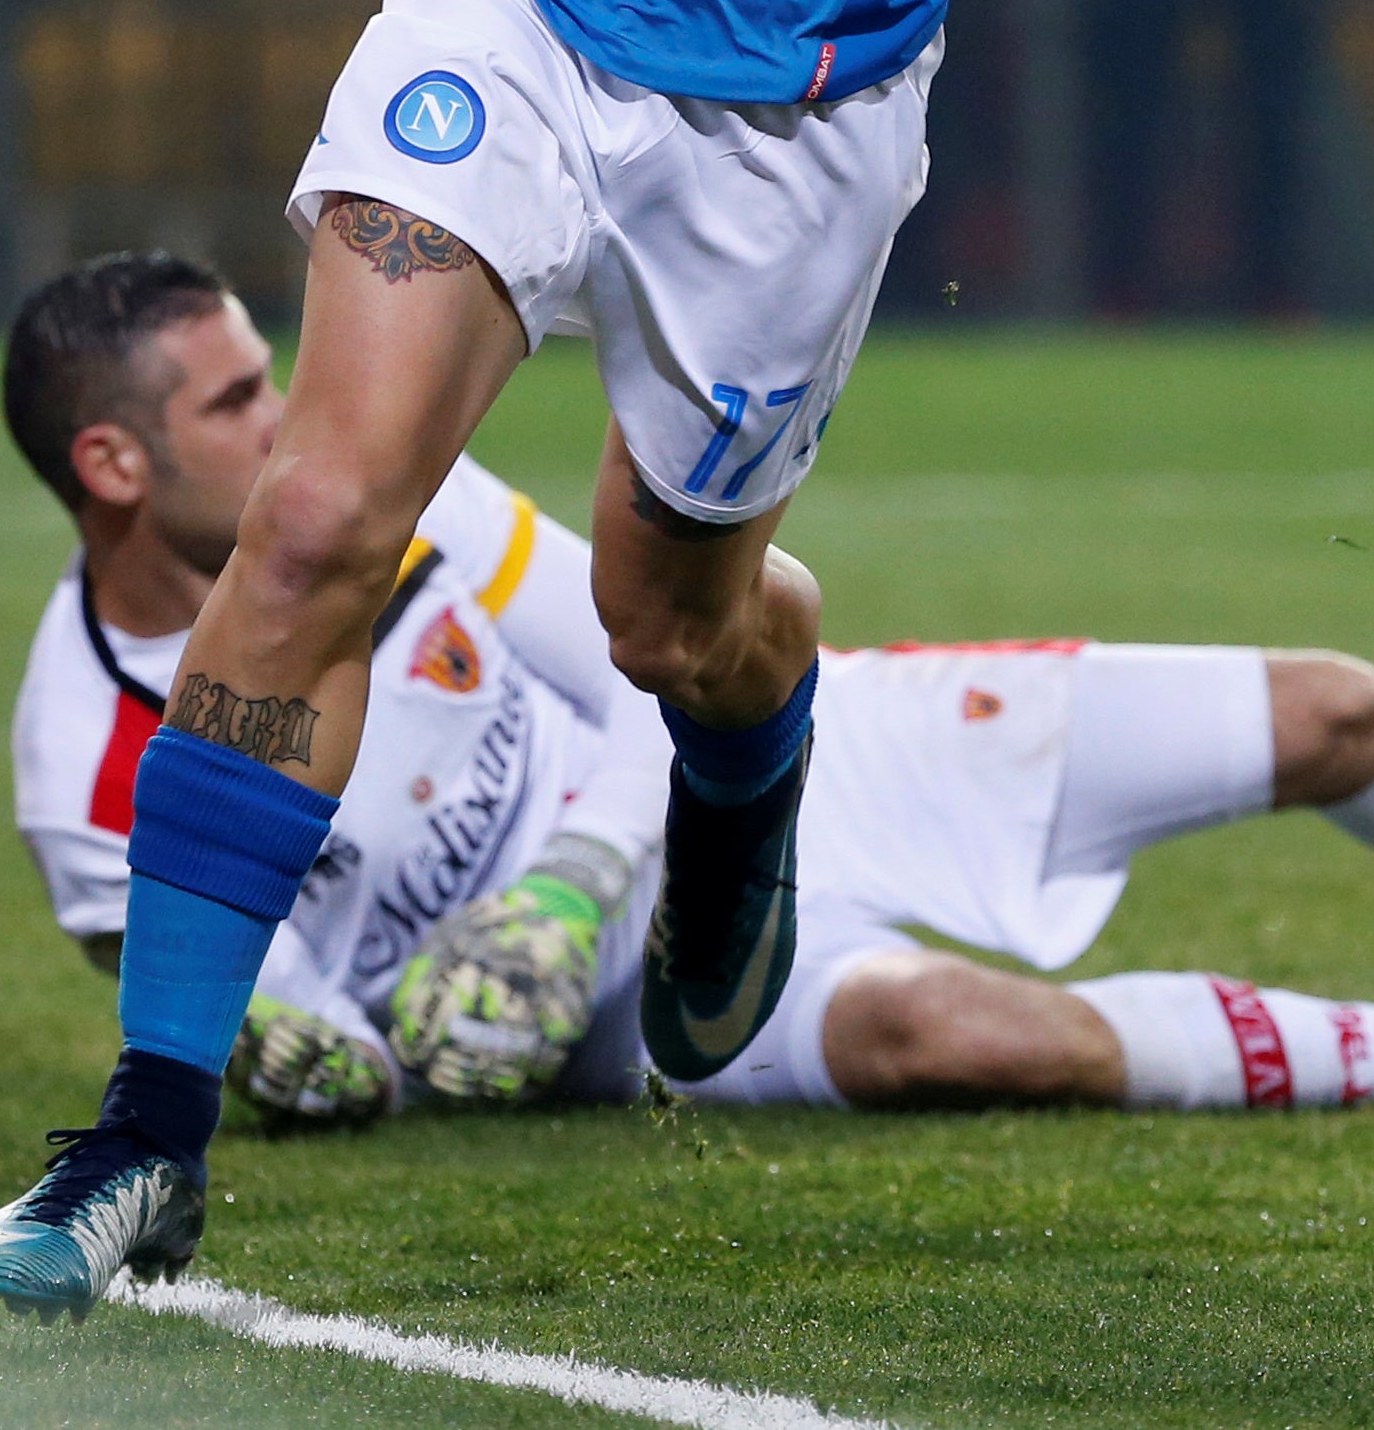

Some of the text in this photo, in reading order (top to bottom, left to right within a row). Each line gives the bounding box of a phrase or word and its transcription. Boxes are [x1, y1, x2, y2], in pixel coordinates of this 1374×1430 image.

[807, 46, 832, 99] OMBAT
[406, 91, 463, 140] N
[684, 379, 814, 501] 17
